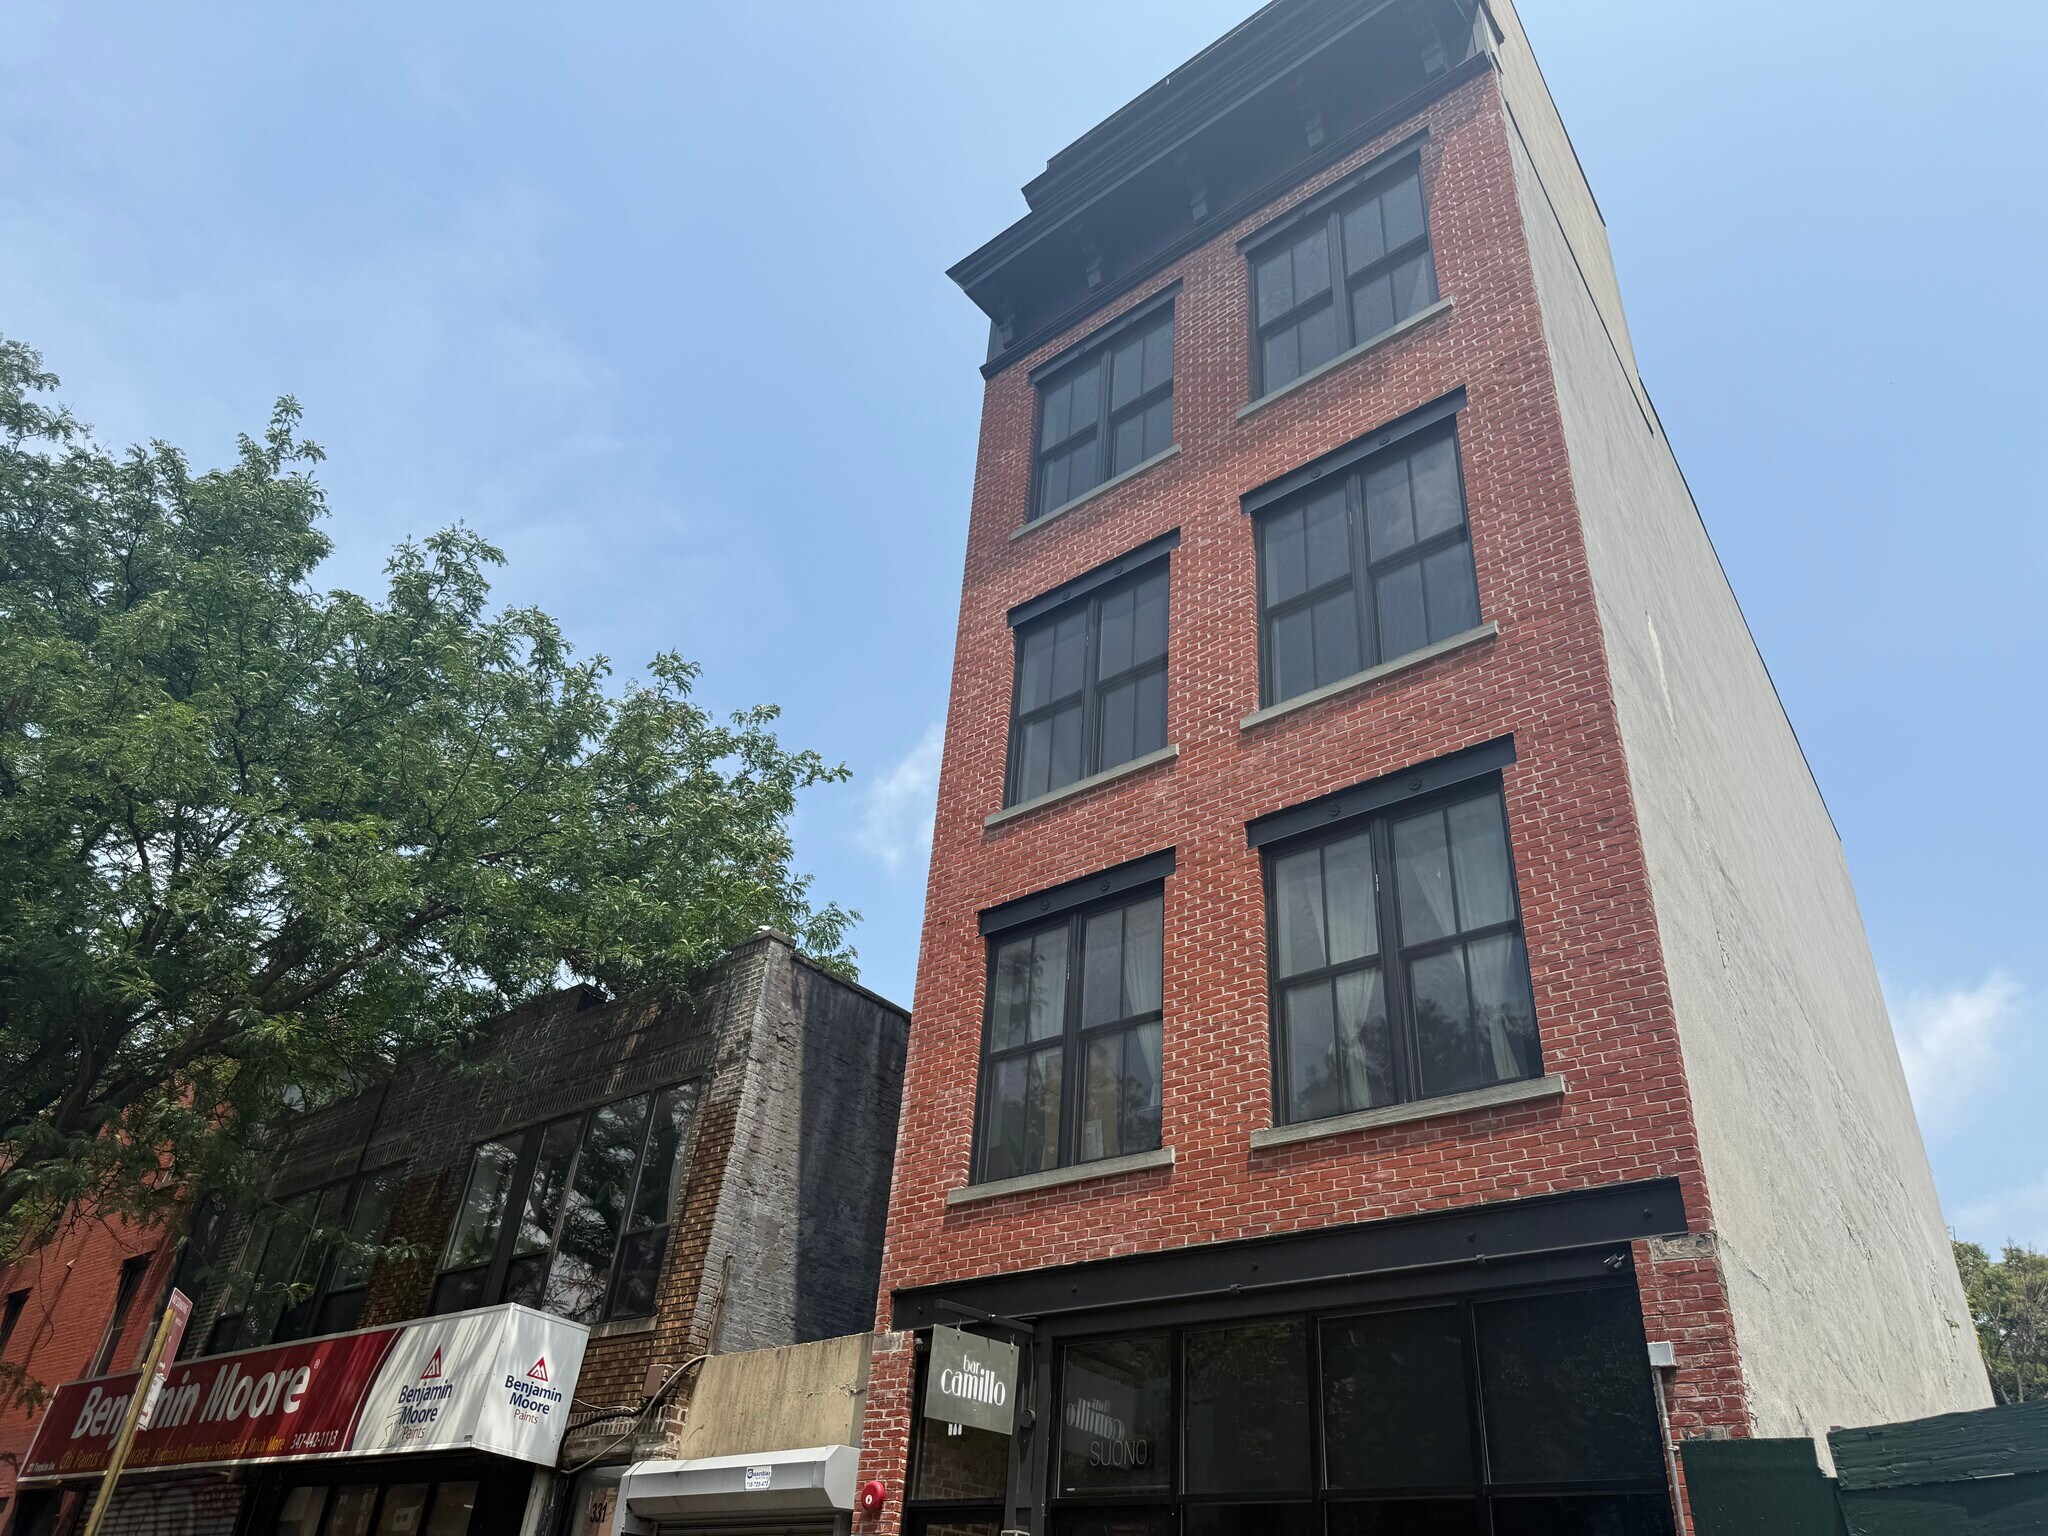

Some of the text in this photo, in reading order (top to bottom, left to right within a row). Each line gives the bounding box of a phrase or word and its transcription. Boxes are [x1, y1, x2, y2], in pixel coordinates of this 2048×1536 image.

[963, 1354, 981, 1375] bar
[398, 1380, 453, 1407] Benjamin
[504, 1375, 562, 1403] Benjamin
[941, 1368, 1006, 1406] camillo
[71, 1370, 200, 1451] Benjmin
[200, 1362, 310, 1424] Moore
[509, 1393, 550, 1414] Moore
[399, 1405, 438, 1425] Moore
[513, 1409, 538, 1424] Paints
[267, 1437, 285, 1451] More
[291, 1430, 338, 1449] 347-442-1113
[401, 1426, 426, 1441] Paints
[1090, 1439, 1148, 1466] SUONO
[590, 1502, 608, 1523] 331
